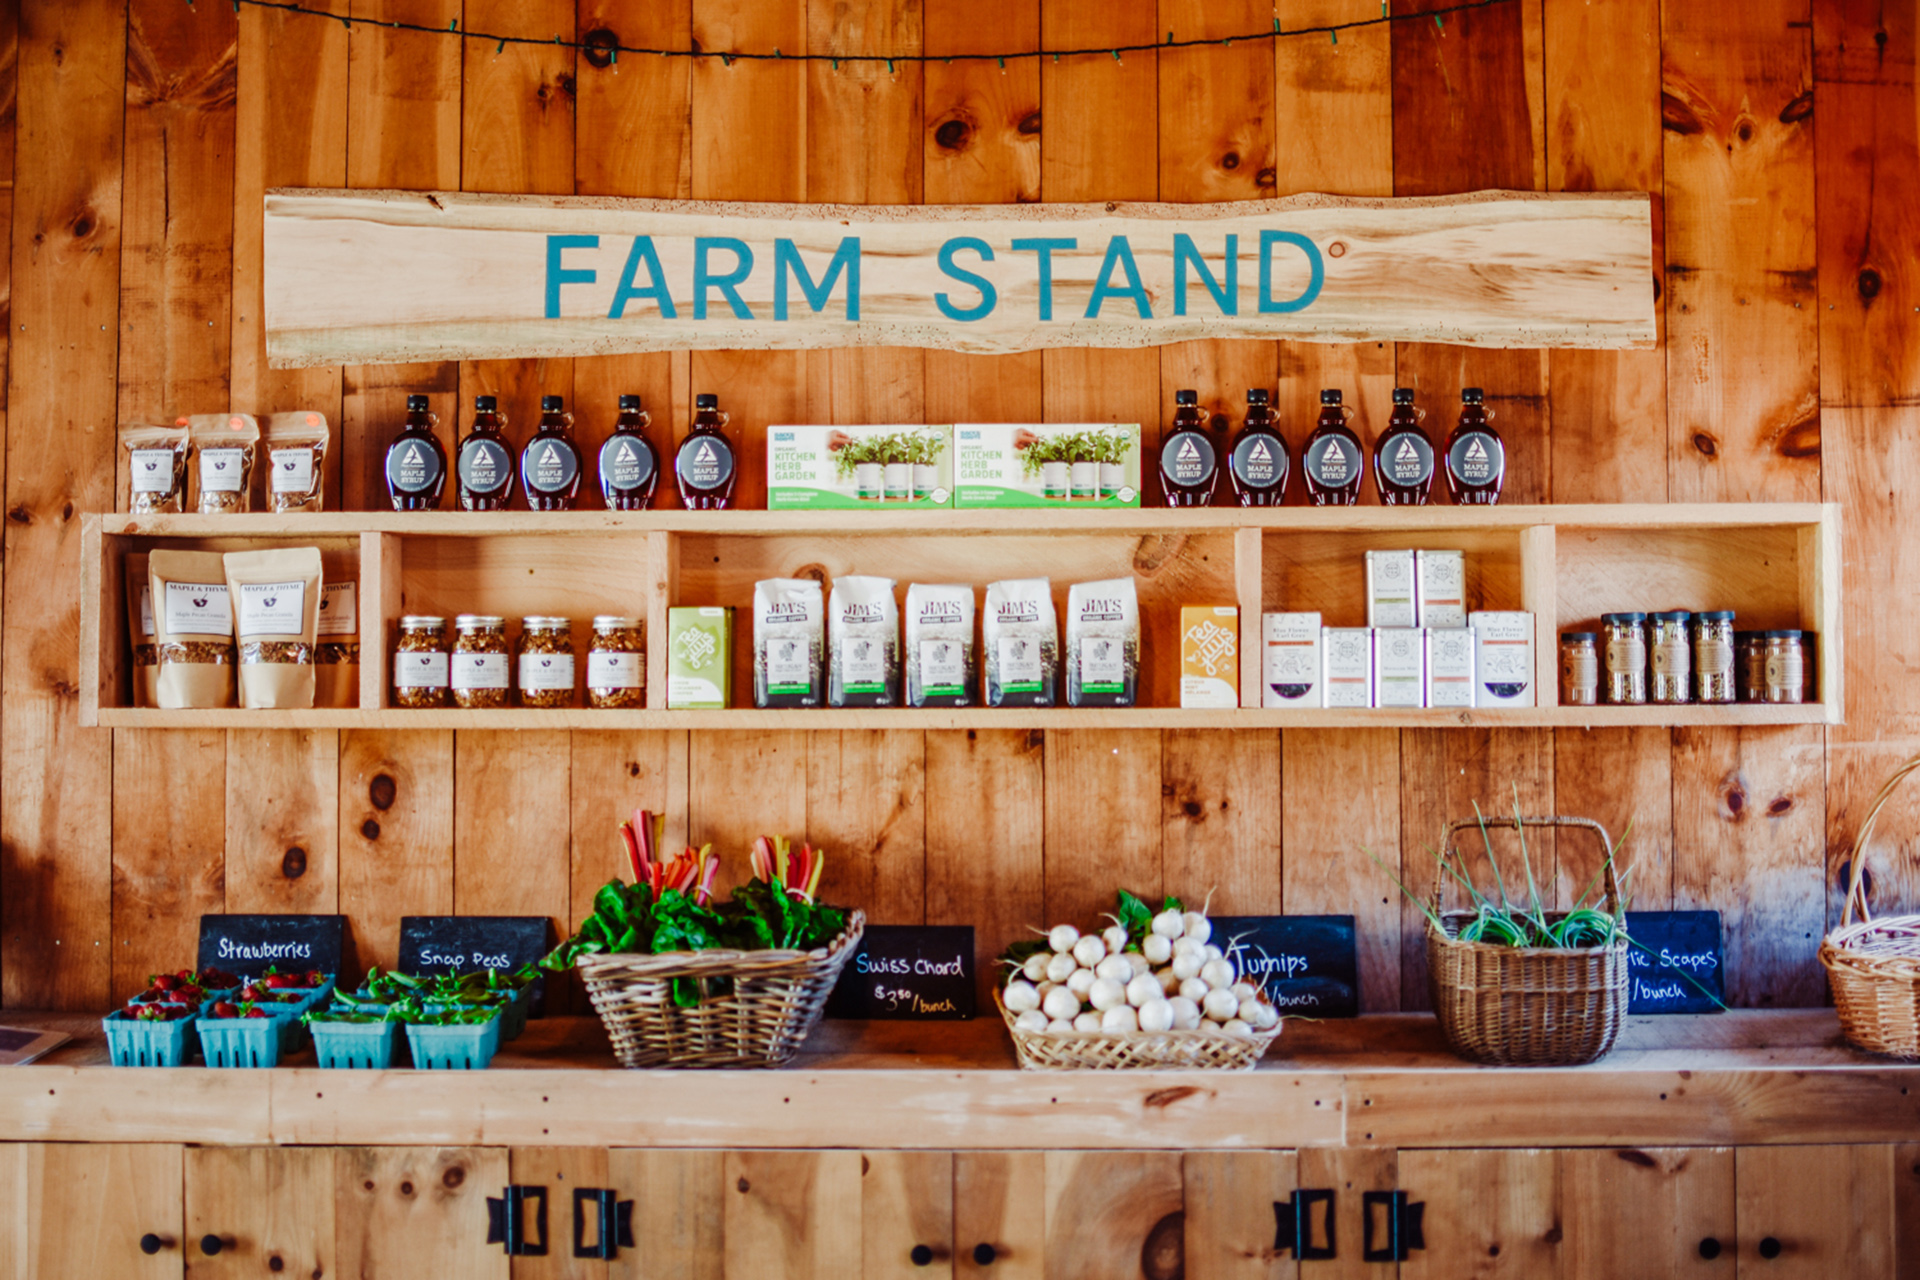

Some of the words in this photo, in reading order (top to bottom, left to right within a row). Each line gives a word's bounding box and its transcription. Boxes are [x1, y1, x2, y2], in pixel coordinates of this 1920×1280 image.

[545, 235, 860, 321] FARM
[935, 230, 1324, 322] STAND
[775, 452, 816, 461] KITCHEN
[961, 451, 1002, 459] KITCHEN
[775, 462, 801, 470] HERB
[961, 461, 987, 469] HERB
[775, 471, 816, 480] GARDEN
[961, 470, 1002, 478] GARDEN
[170, 584, 195, 592] MAPLE
[244, 584, 268, 592] MAPLE
[767, 602, 806, 614] JIM'S
[844, 602, 882, 615] JIM'S
[921, 601, 961, 615] JIM'S
[998, 600, 1038, 614] JIM'S
[1082, 600, 1122, 612] JIM'S
[1183, 620, 1218, 645] Tea
[218, 937, 311, 959] Strawberries
[420, 950, 465, 967] Snap
[473, 951, 511, 968] Peas
[856, 953, 911, 974] Swiss
[914, 955, 965, 978] Chard
[1231, 945, 1309, 978] Turnips
[1626, 951, 1650, 967] lic
[1660, 948, 1718, 972] Scapes
[1633, 977, 1687, 1001] /bunch
